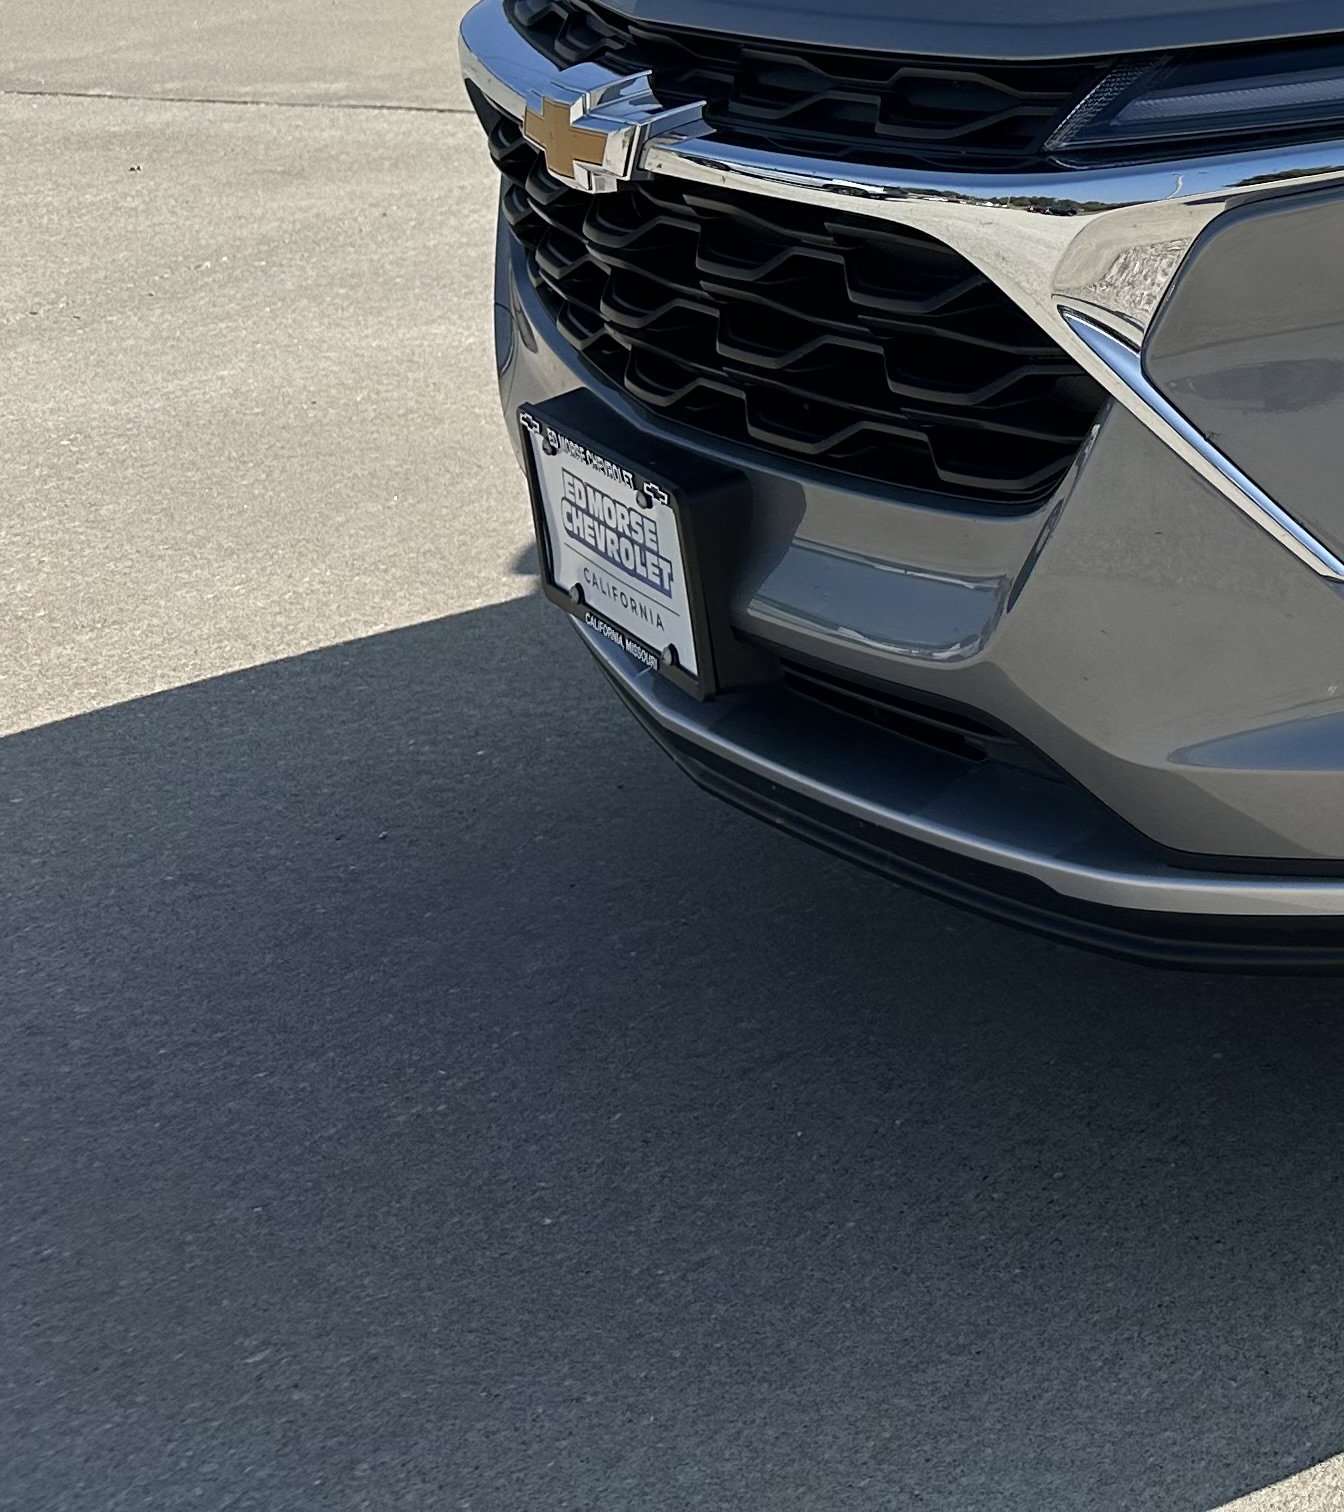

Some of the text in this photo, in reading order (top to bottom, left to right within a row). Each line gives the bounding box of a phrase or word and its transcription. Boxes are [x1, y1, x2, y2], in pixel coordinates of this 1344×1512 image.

[558, 434, 586, 463] MORSE
[586, 449, 635, 489] CHEVROLET
[561, 496, 673, 597] CHEVROLET
[583, 567, 665, 632] CALIFORNIA
[624, 638, 658, 671] MISSOURI
